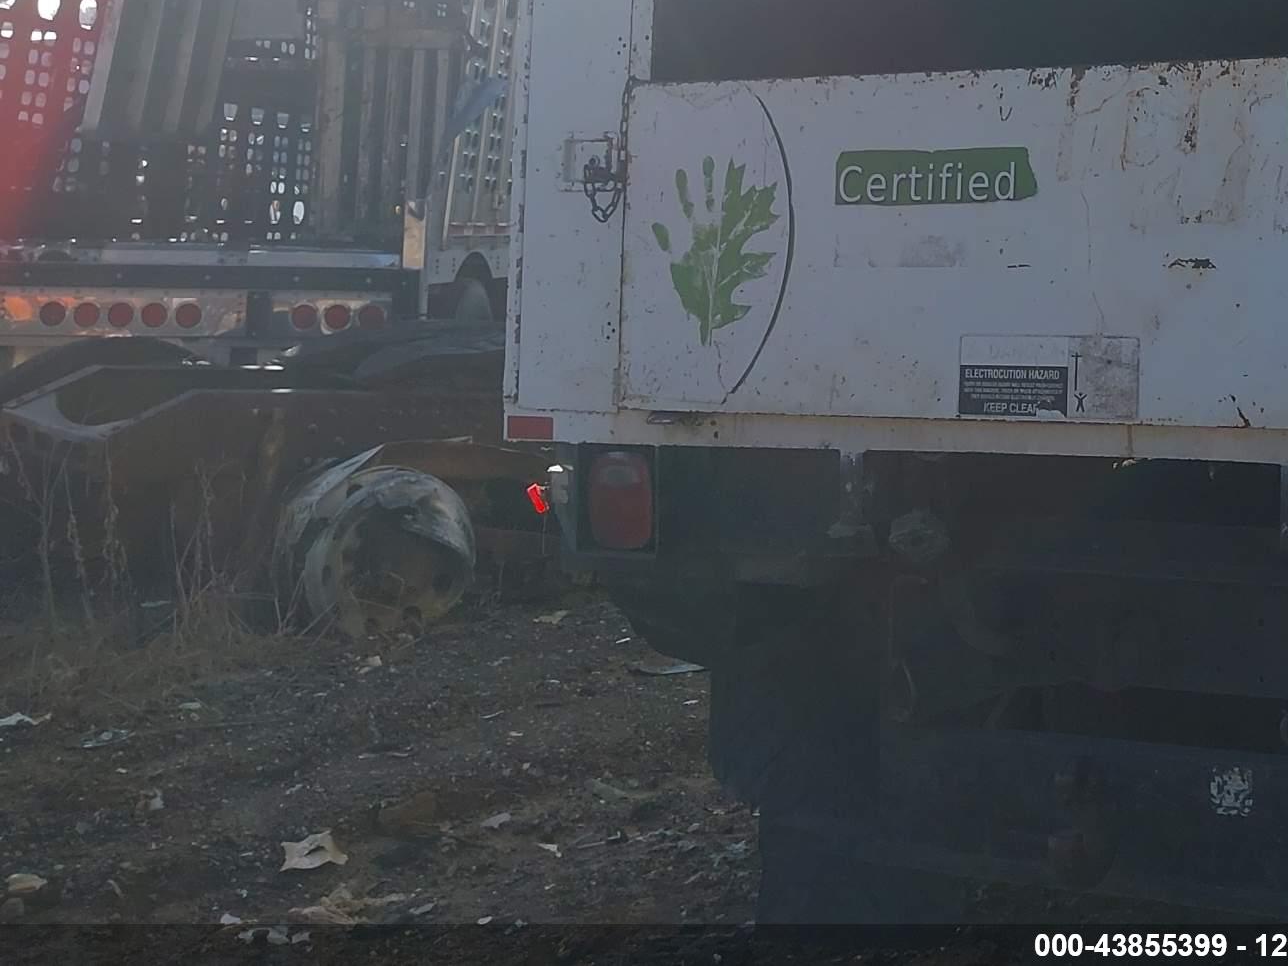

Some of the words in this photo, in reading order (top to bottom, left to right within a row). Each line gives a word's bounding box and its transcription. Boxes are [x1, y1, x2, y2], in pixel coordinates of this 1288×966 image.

[838, 161, 1016, 203] Certified
[965, 368, 1027, 379] ELECTROCUTION
[1028, 369, 1060, 380] HAZARD
[983, 401, 1008, 413] KEEP
